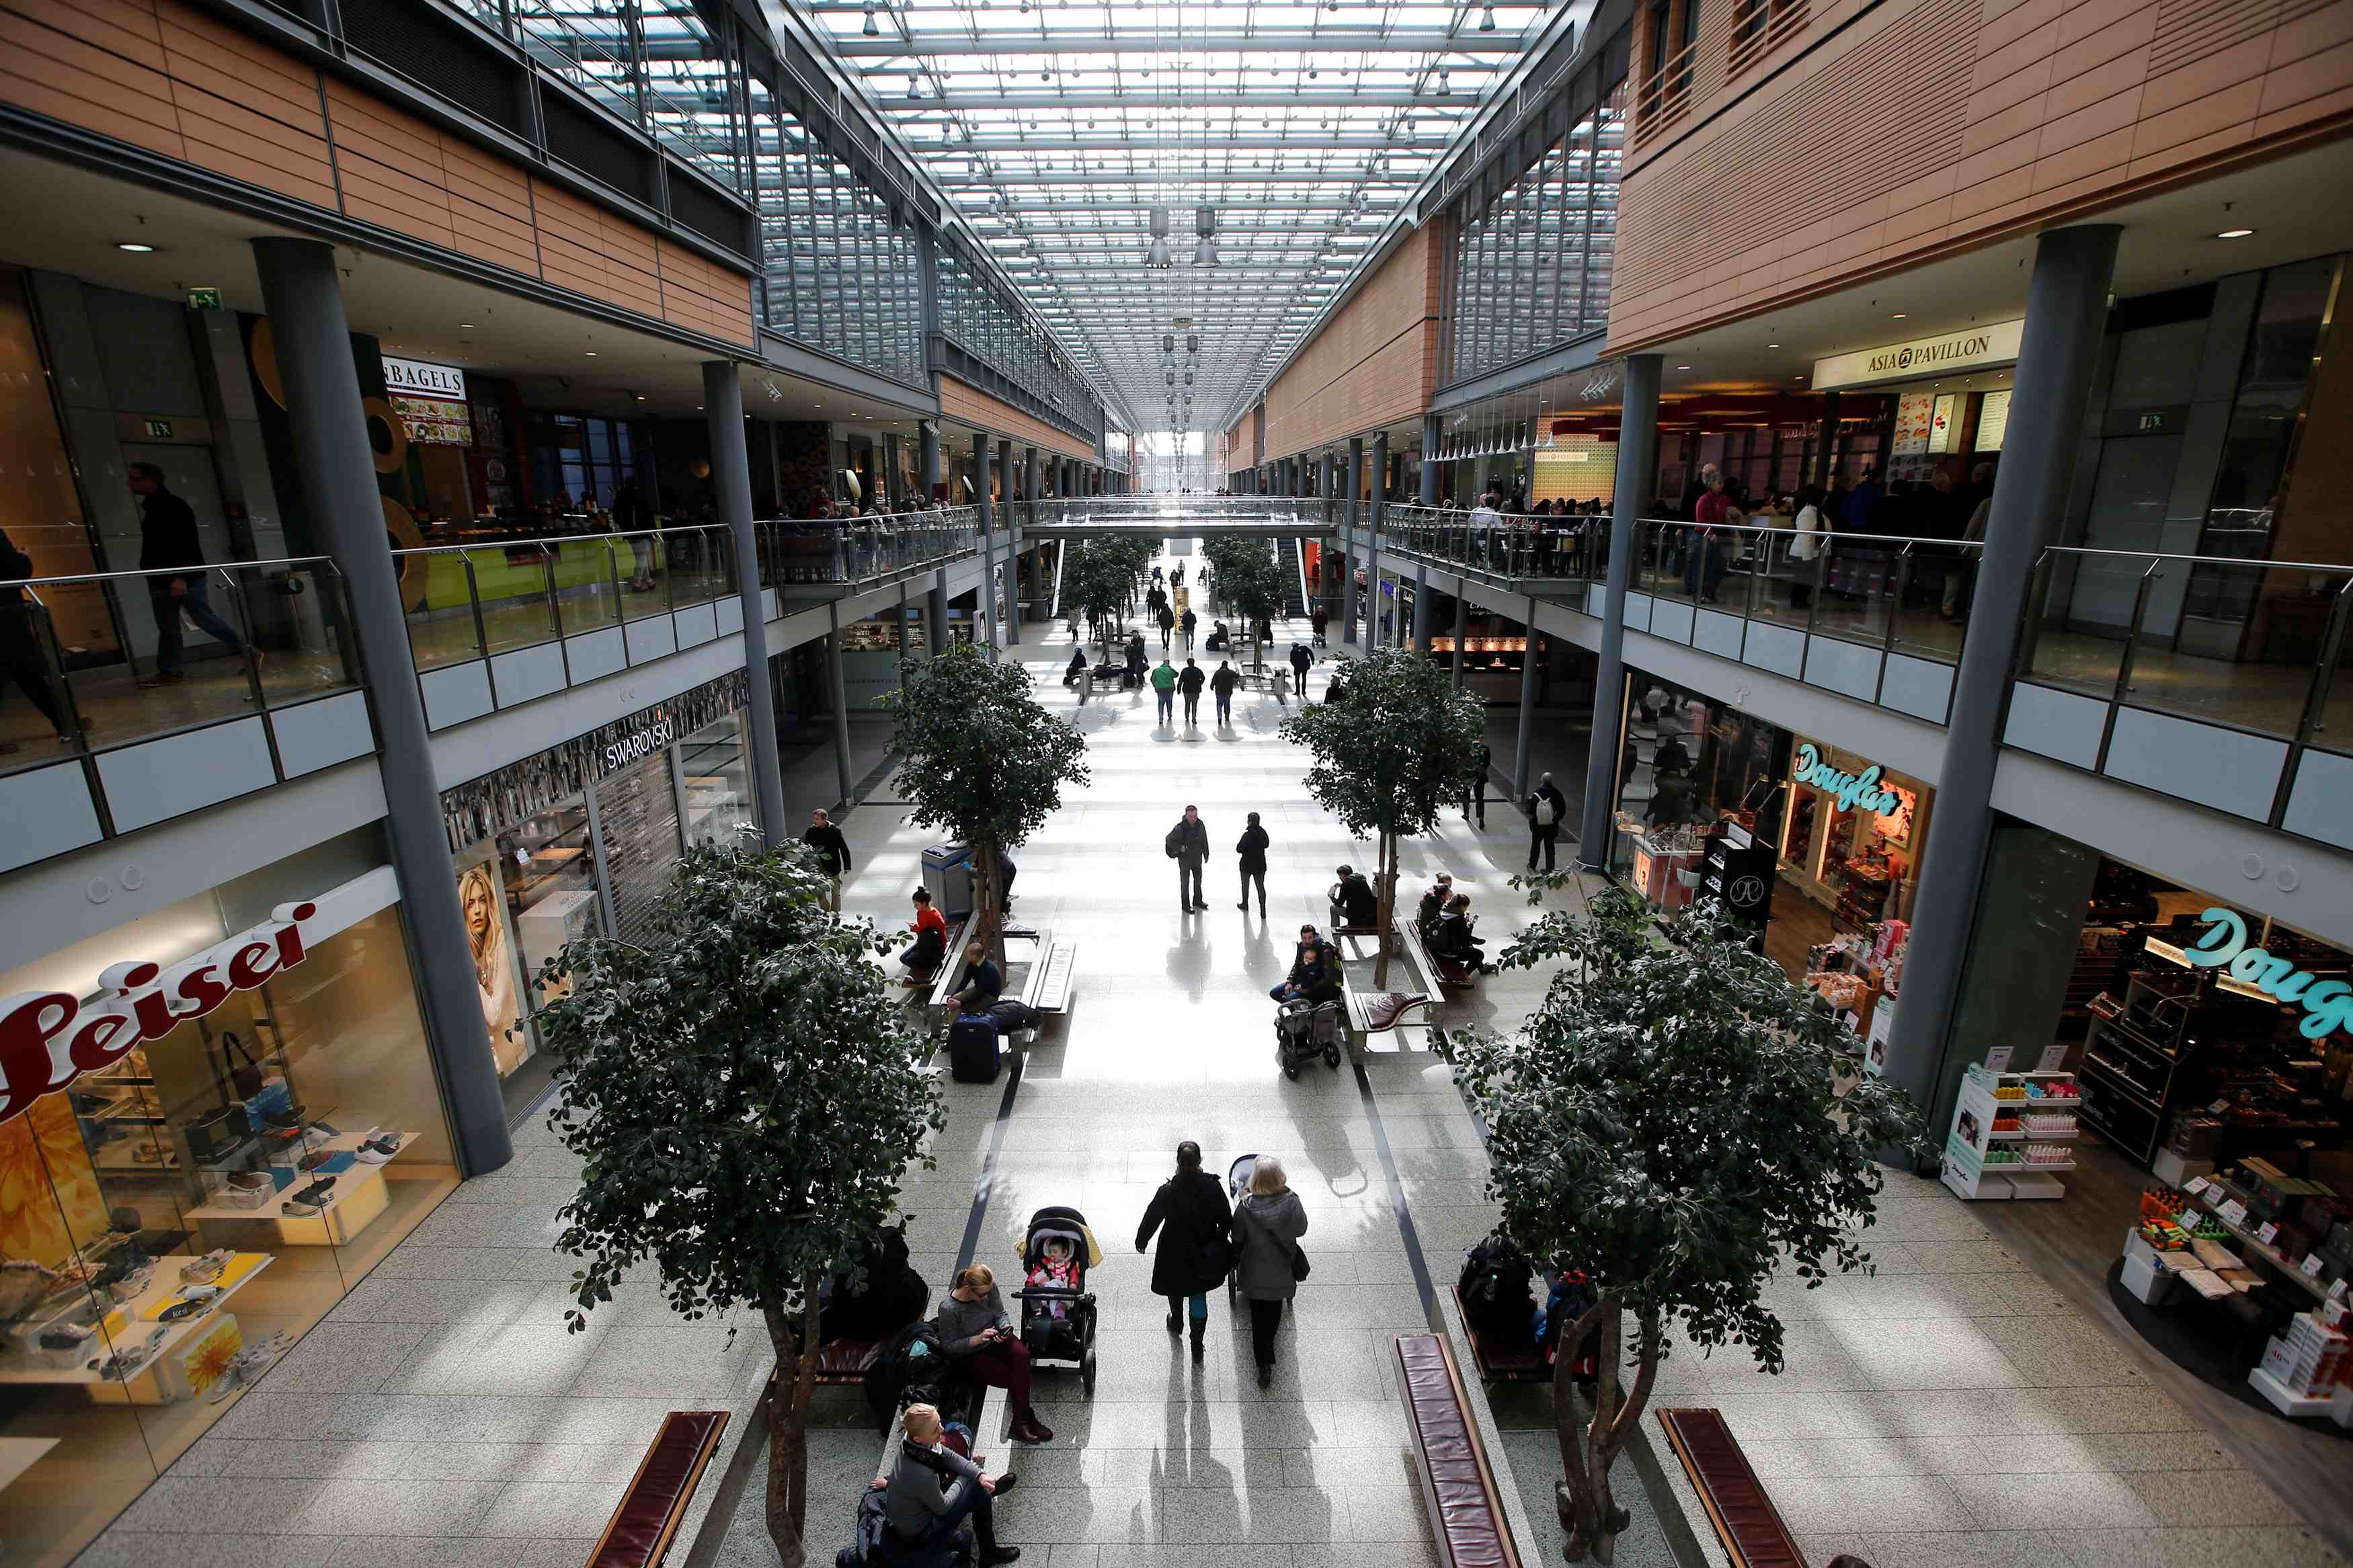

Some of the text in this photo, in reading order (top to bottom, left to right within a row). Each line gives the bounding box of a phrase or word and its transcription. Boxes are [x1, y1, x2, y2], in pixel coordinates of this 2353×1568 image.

[1868, 335, 1991, 372] ASIA PAVILLON
[606, 720, 673, 769] SWAROVSKI
[1794, 743, 1898, 817] Douglas
[2184, 907, 2353, 1039] Doug
